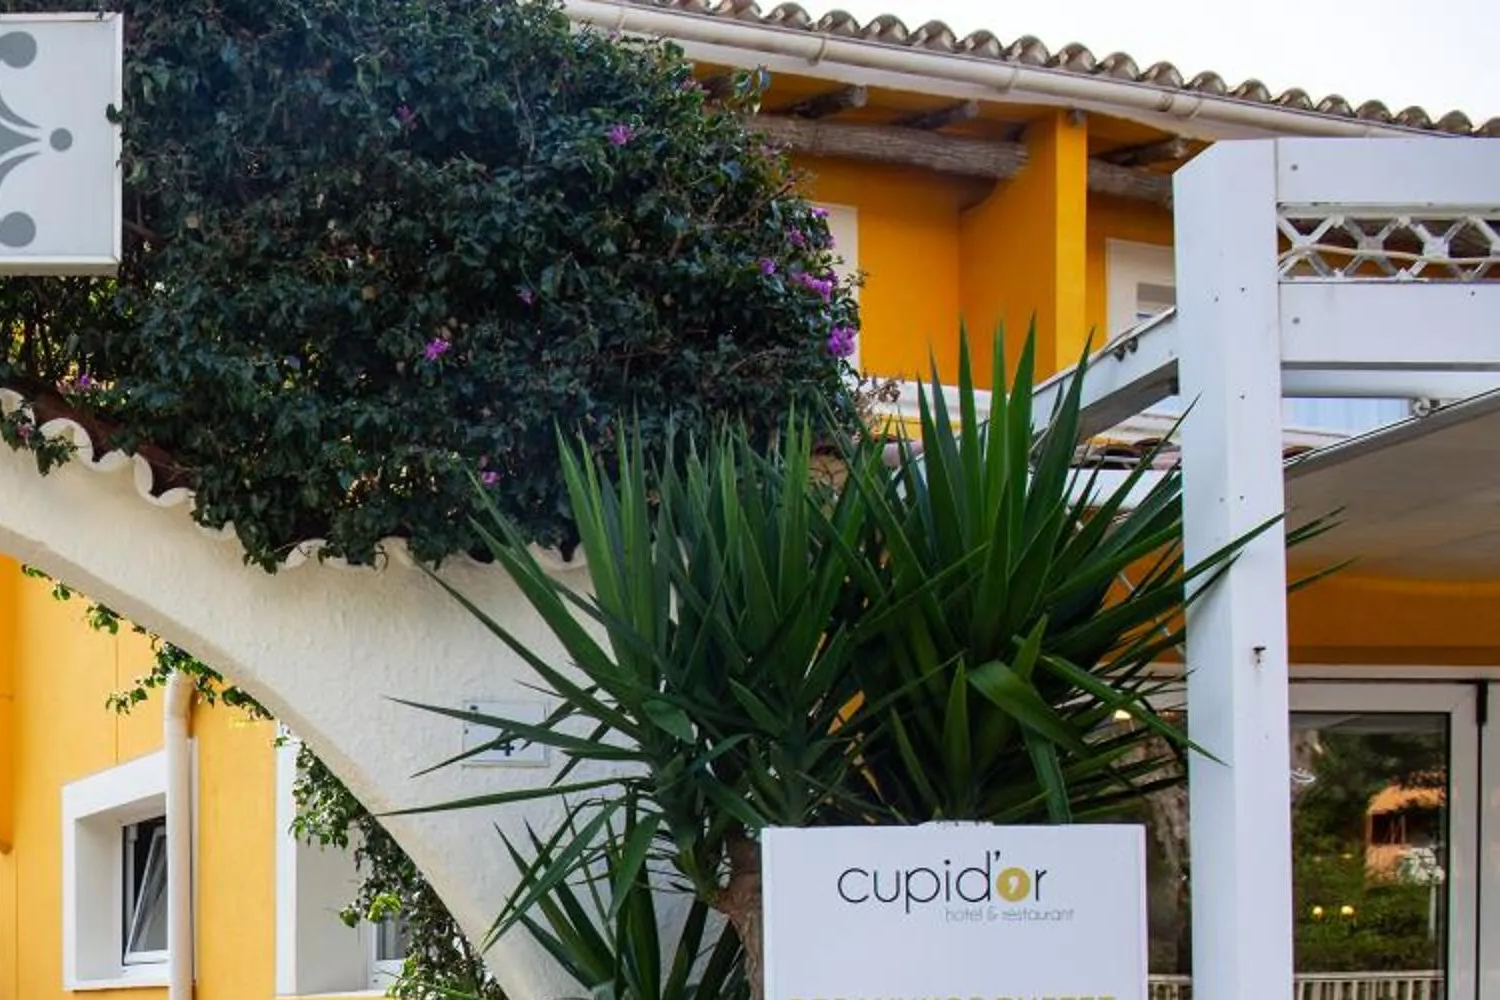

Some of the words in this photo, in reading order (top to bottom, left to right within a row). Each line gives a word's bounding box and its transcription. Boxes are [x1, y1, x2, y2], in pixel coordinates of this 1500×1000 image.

[837, 850, 1048, 914] cupid'or
[945, 906, 983, 923] hotel
[987, 906, 998, 921] &
[1002, 907, 1075, 922] restaurant
